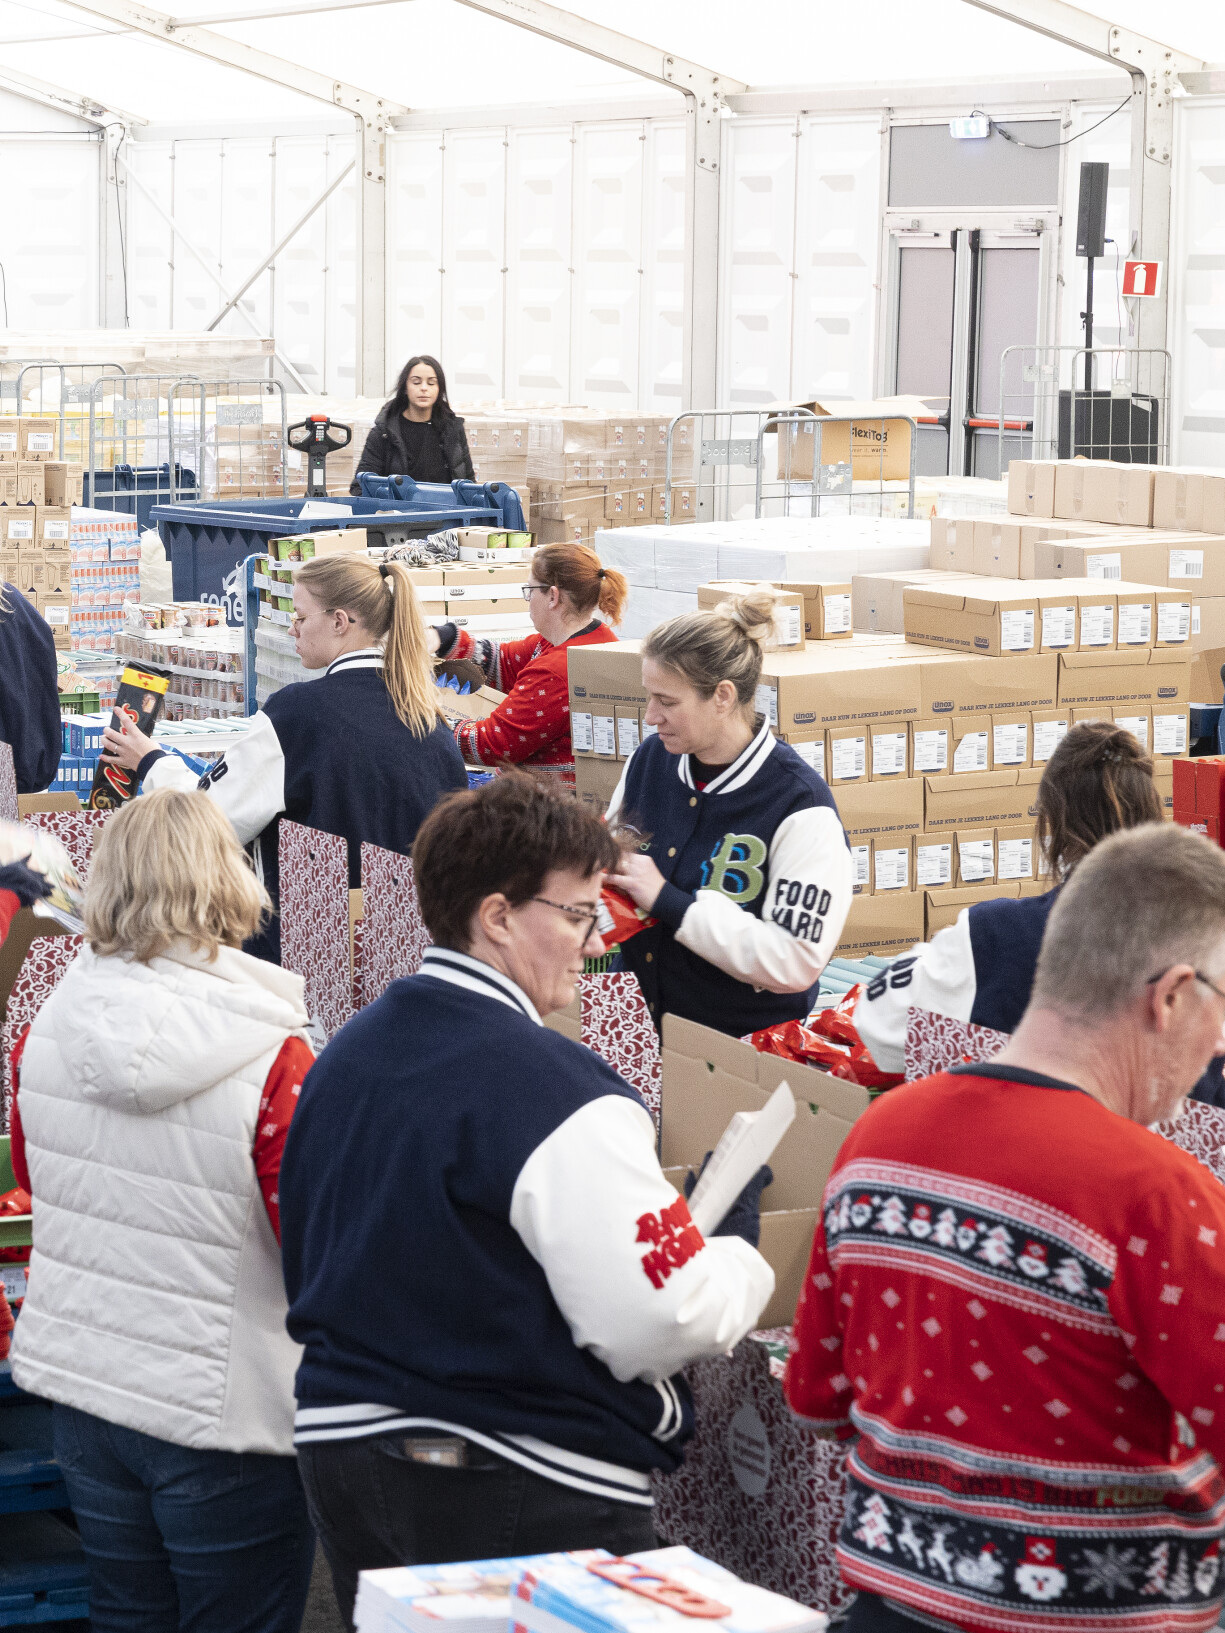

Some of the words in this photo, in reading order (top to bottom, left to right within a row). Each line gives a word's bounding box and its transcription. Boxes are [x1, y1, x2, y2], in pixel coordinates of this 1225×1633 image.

[1016, 700, 1030, 708] LANG
[1039, 698, 1053, 706] DOOR
[821, 715, 837, 723] DAAR
[858, 711, 878, 719] LEKKER
[879, 710, 894, 718] LANG
[903, 707, 917, 715] DOOR
[928, 818, 944, 826] DAAR
[945, 817, 957, 825] KUN
[964, 815, 984, 823] LEKKER
[859, 826, 880, 835] LEKKER
[881, 825, 896, 833] LANG
[774, 877, 833, 917] FOOD
[771, 907, 825, 944] YARD
[859, 941, 881, 949] LEKKER
[881, 939, 896, 947] LANG
